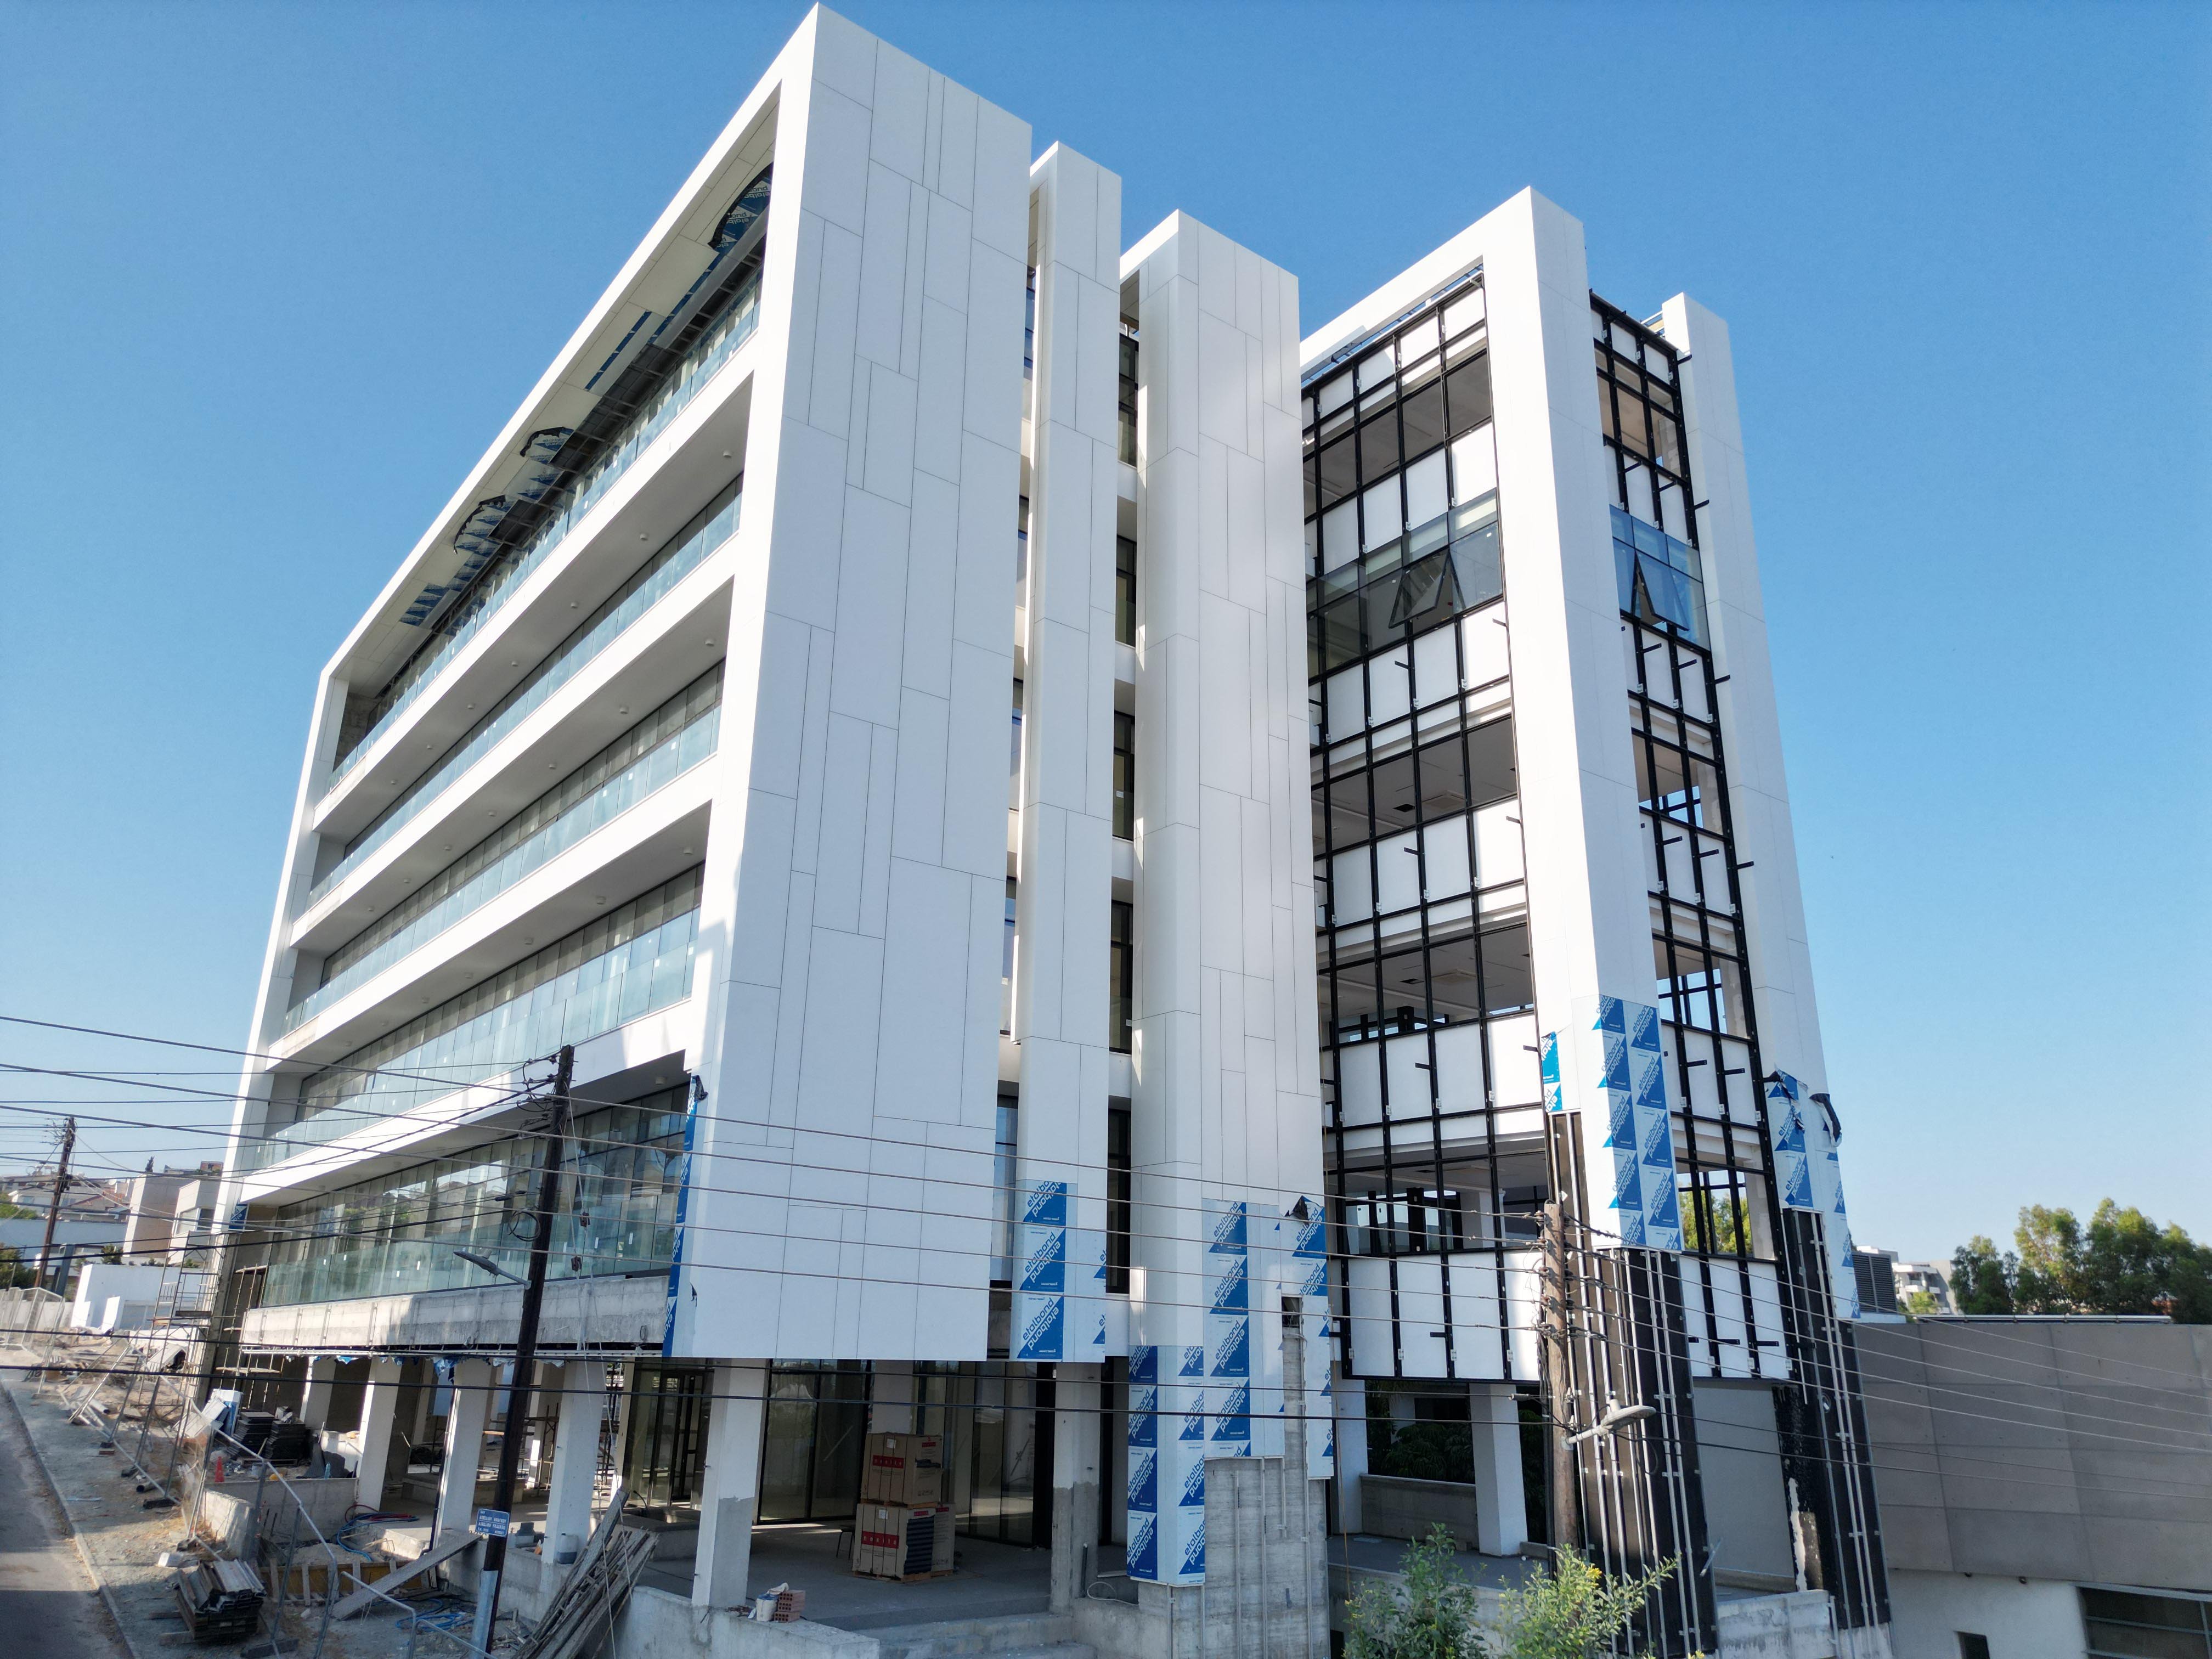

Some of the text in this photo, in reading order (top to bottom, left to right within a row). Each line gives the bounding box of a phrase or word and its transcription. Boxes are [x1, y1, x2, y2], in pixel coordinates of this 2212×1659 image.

[1637, 1008, 1654, 1042] etalbond
[1606, 1046, 1624, 1081] etalbond
[1639, 1056, 1656, 1090] etalbond
[1642, 1064, 1660, 1099] etalbond
[1612, 1104, 1630, 1140] etalbond
[1644, 1113, 1661, 1149] etalbond
[1648, 1122, 1666, 1158] etalbond
[1618, 1164, 1636, 1201] etalbond
[1650, 1172, 1668, 1210] etalbond
[1785, 1155, 1802, 1190] etalbond
[1214, 1201, 1238, 1237] etalbond
[1654, 1181, 1672, 1219] etalbond
[1218, 1209, 1243, 1246] etalbond
[1296, 1207, 1318, 1242] etalbnd
[1025, 1232, 1056, 1273] etalbond
[1029, 1241, 1061, 1283] etalbond
[1214, 1260, 1239, 1298] etalbond
[1218, 1268, 1244, 1307] etalbond
[1023, 1297, 1054, 1340] etalbond
[1028, 1306, 1059, 1351] etalbond
[1215, 1320, 1240, 1361] etalbond
[1220, 1328, 1245, 1369] etalbond
[1128, 1389, 1150, 1426] etabond
[1127, 1453, 1150, 1493] etalbond
[1131, 1461, 1154, 1502] etalbond
[1127, 1518, 1150, 1558] etalbond
[1130, 1527, 1154, 1568] etalbond
